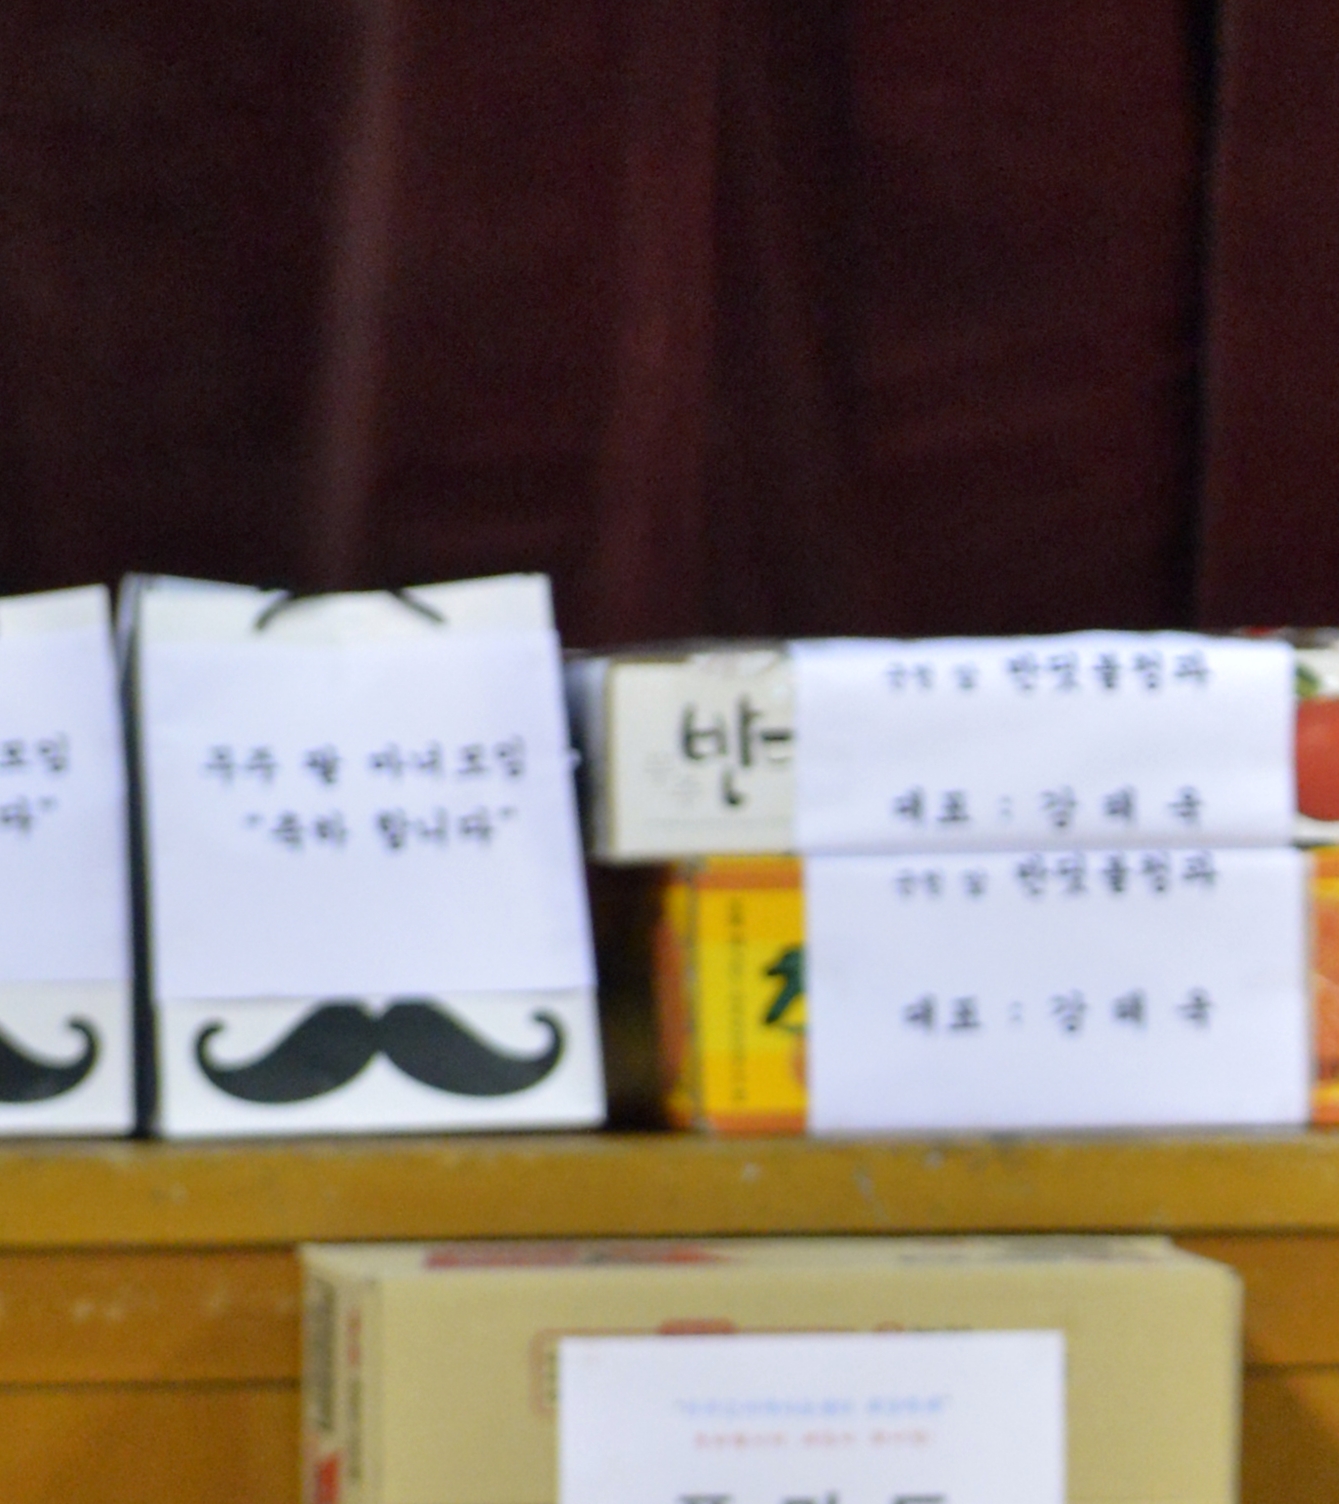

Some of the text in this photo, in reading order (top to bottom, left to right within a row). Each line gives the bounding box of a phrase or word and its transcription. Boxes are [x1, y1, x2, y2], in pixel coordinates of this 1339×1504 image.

[202, 743, 280, 786] 무주
[892, 788, 972, 831] 대표
[902, 995, 982, 1035] 대표
